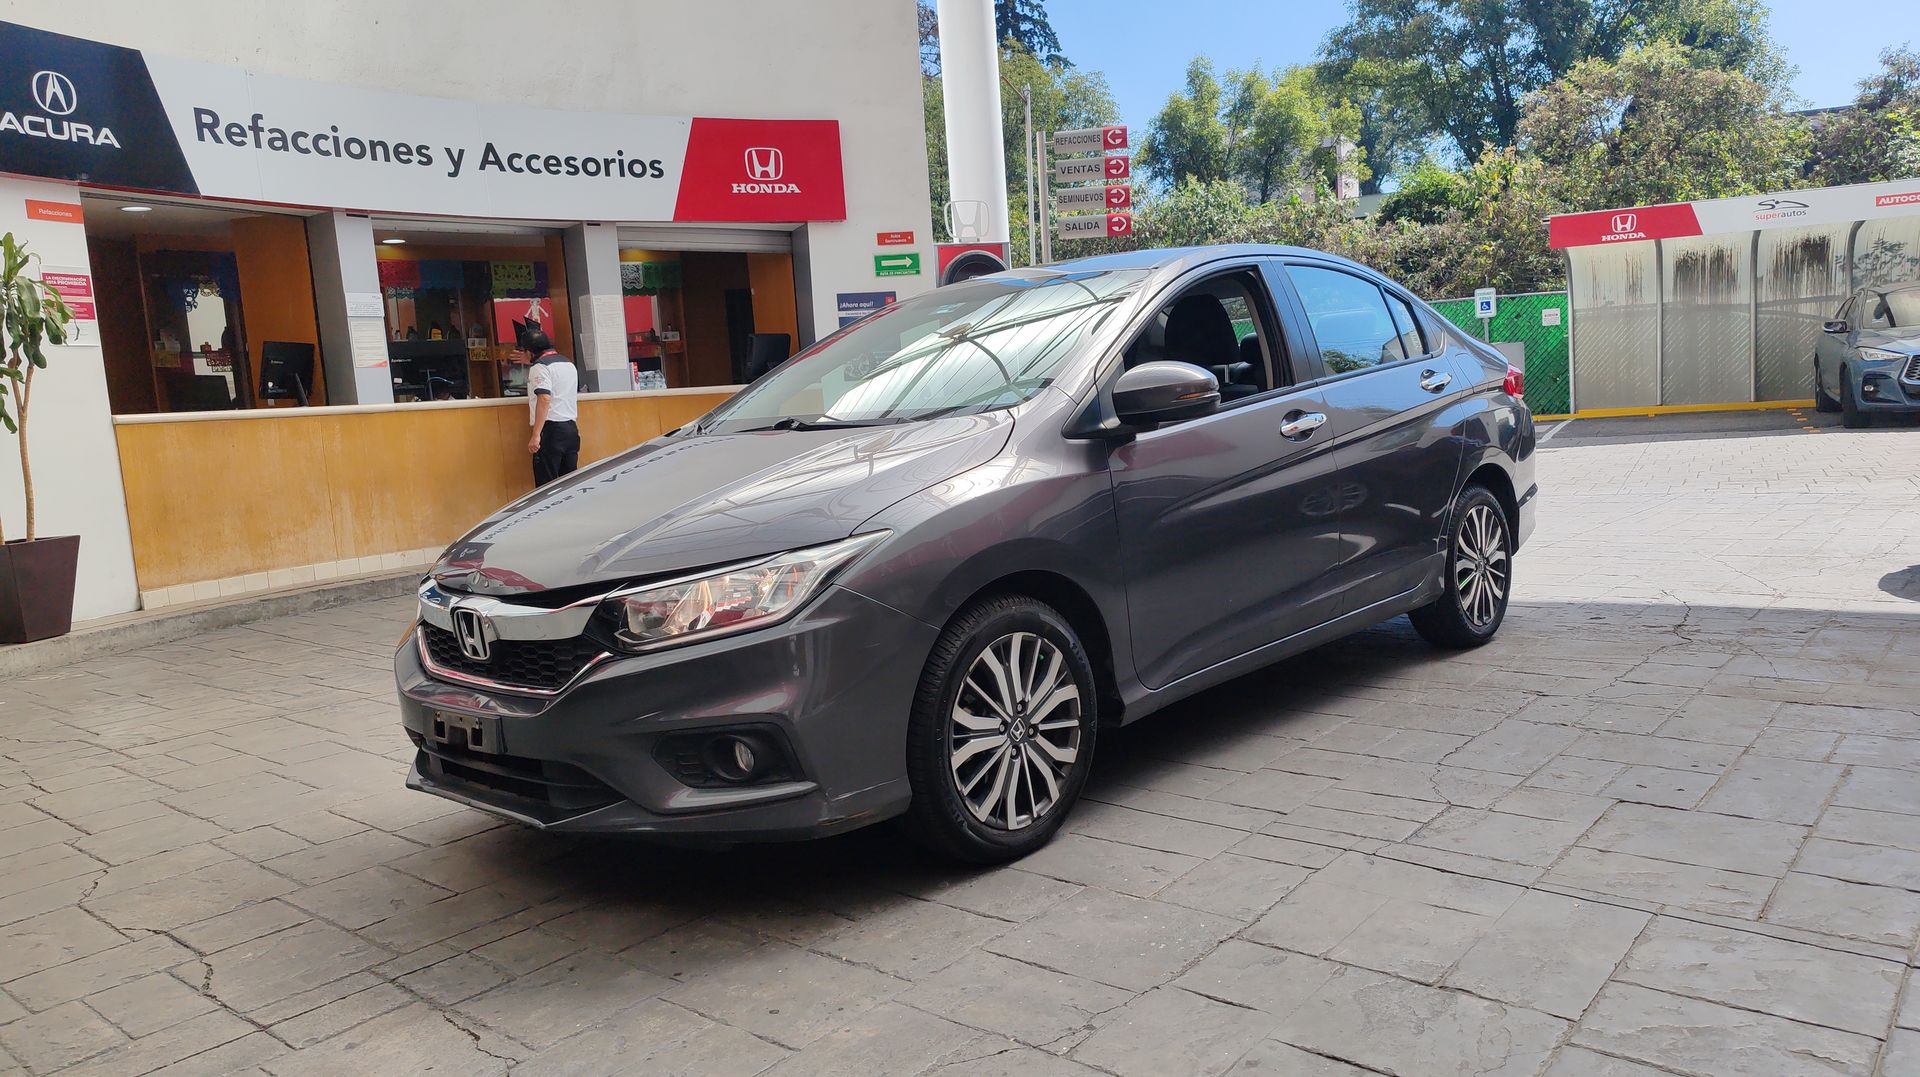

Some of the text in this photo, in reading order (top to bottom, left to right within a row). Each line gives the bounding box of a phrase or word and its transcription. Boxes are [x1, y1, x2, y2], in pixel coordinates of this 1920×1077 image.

[0, 111, 121, 149] ACURA
[193, 107, 665, 179] Refacciones y Accesorios
[1055, 135, 1101, 145] REFACCIONES
[1060, 163, 1101, 175] VENTAS
[731, 183, 802, 194] HONDA
[1058, 192, 1104, 204] SEMINUEVOS
[38, 207, 73, 219] Refacciones
[1755, 209, 1807, 221] superautos
[1065, 221, 1100, 232] SALIDA
[1601, 231, 1647, 242] HONDA
